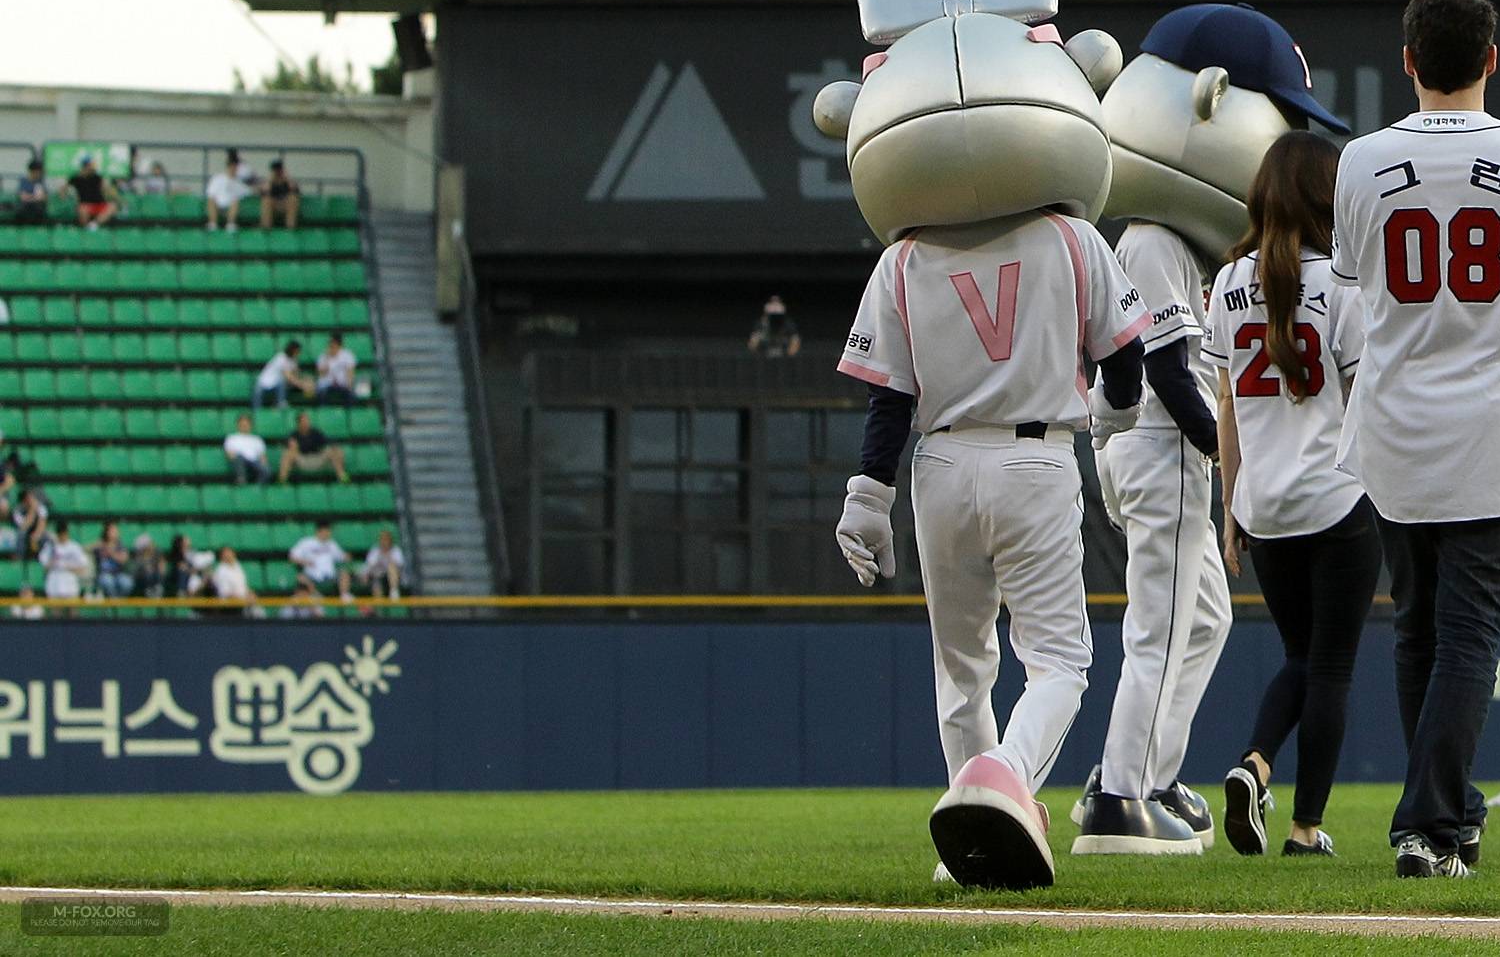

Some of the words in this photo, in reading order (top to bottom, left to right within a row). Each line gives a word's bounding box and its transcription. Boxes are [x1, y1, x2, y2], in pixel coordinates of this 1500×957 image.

[948, 260, 1022, 362] V
[1223, 281, 1328, 317] 메스
[1233, 322, 1326, 398] 28
[0, 679, 200, 760] 위닉스
